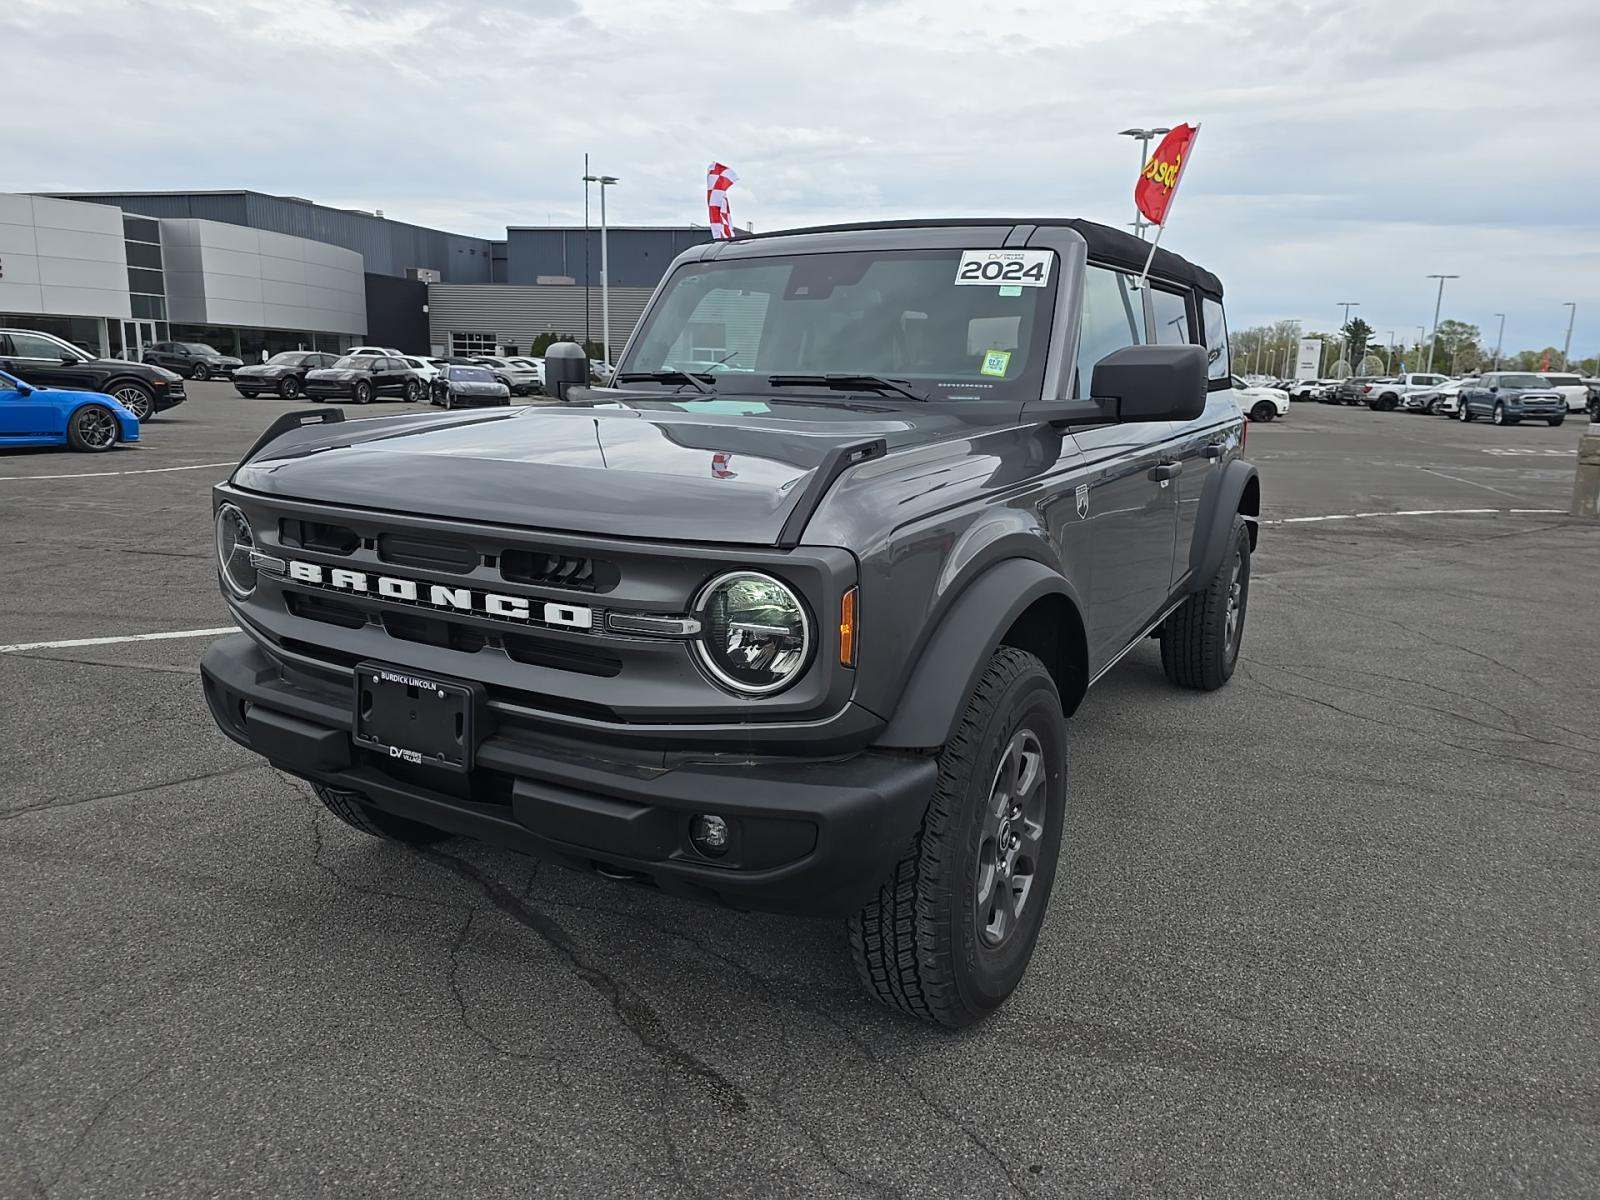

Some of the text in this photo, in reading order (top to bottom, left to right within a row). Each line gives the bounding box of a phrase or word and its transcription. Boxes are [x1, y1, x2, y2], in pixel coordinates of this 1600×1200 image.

[960, 261, 1044, 281] 2024
[289, 560, 592, 628] BRONCO
[381, 673, 437, 690] BURDICK LINCOLN
